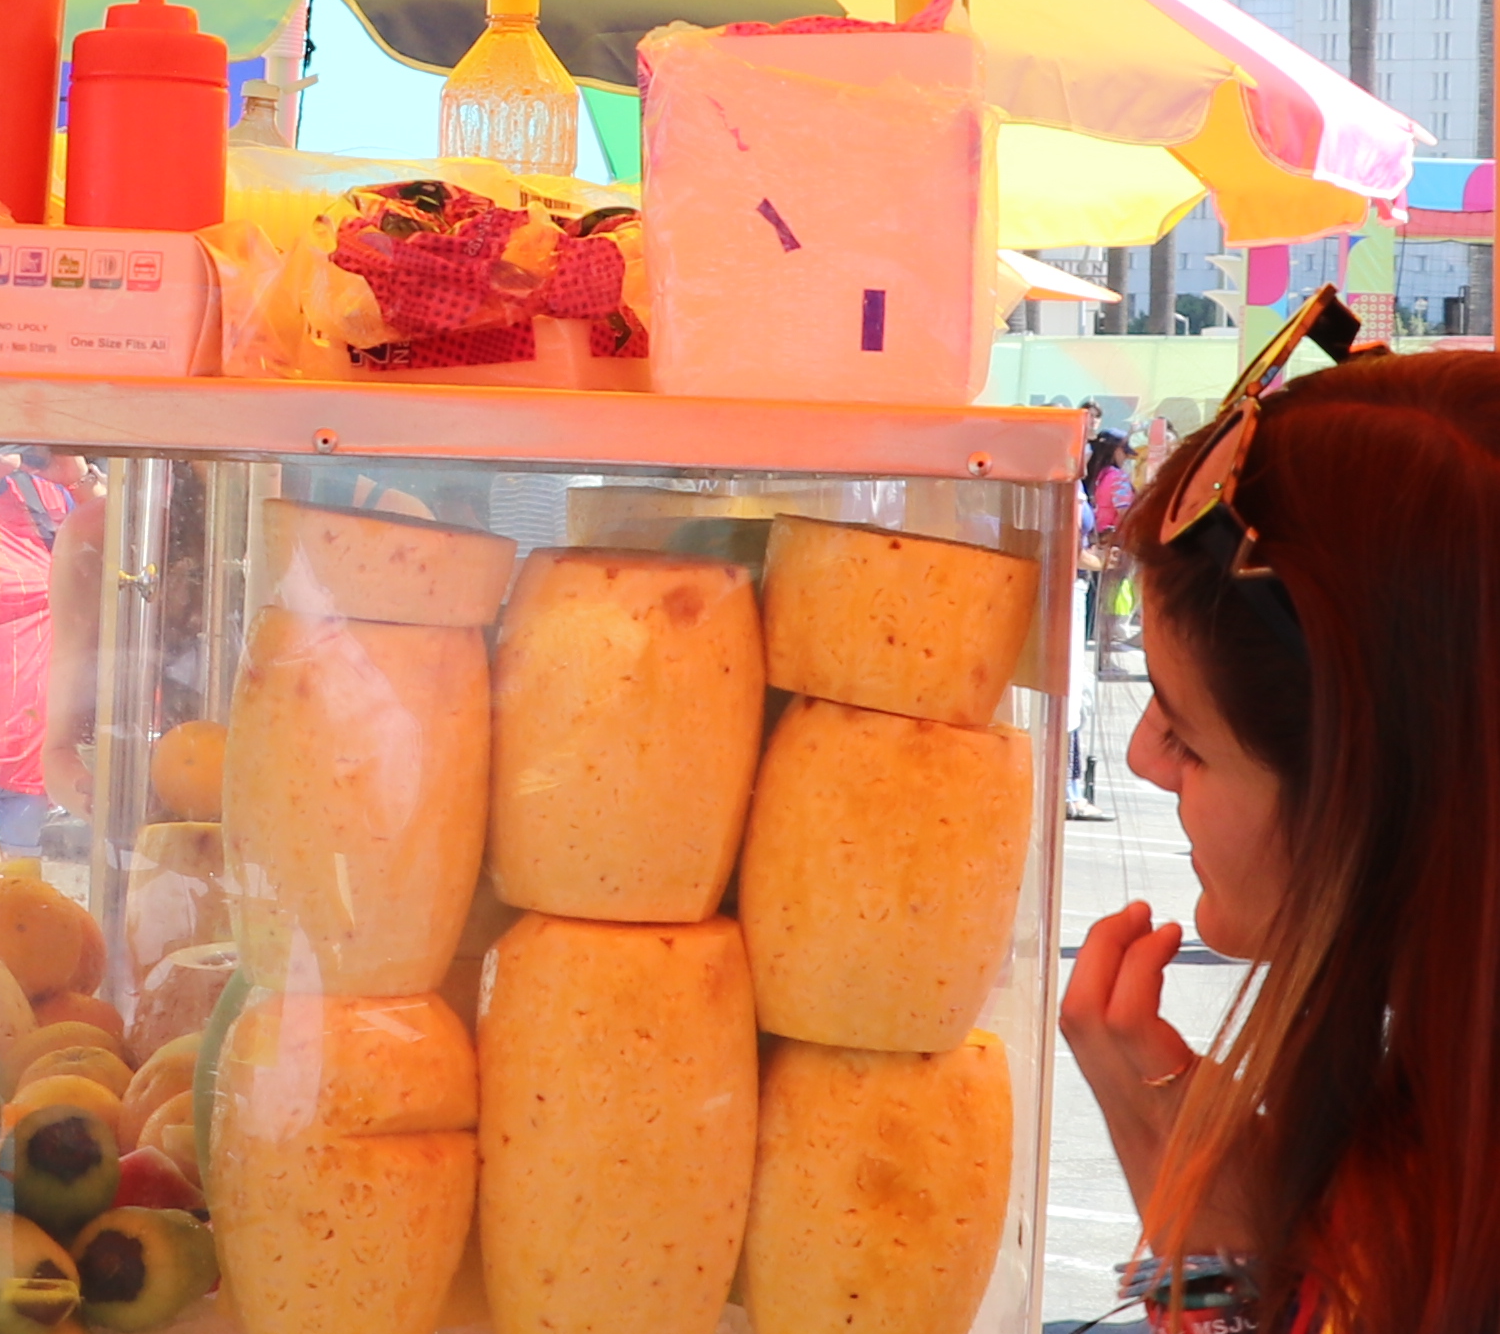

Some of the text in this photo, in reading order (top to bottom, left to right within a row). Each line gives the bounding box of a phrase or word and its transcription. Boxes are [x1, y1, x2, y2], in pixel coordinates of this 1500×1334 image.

[70, 336, 167, 350] One Size Fits All
